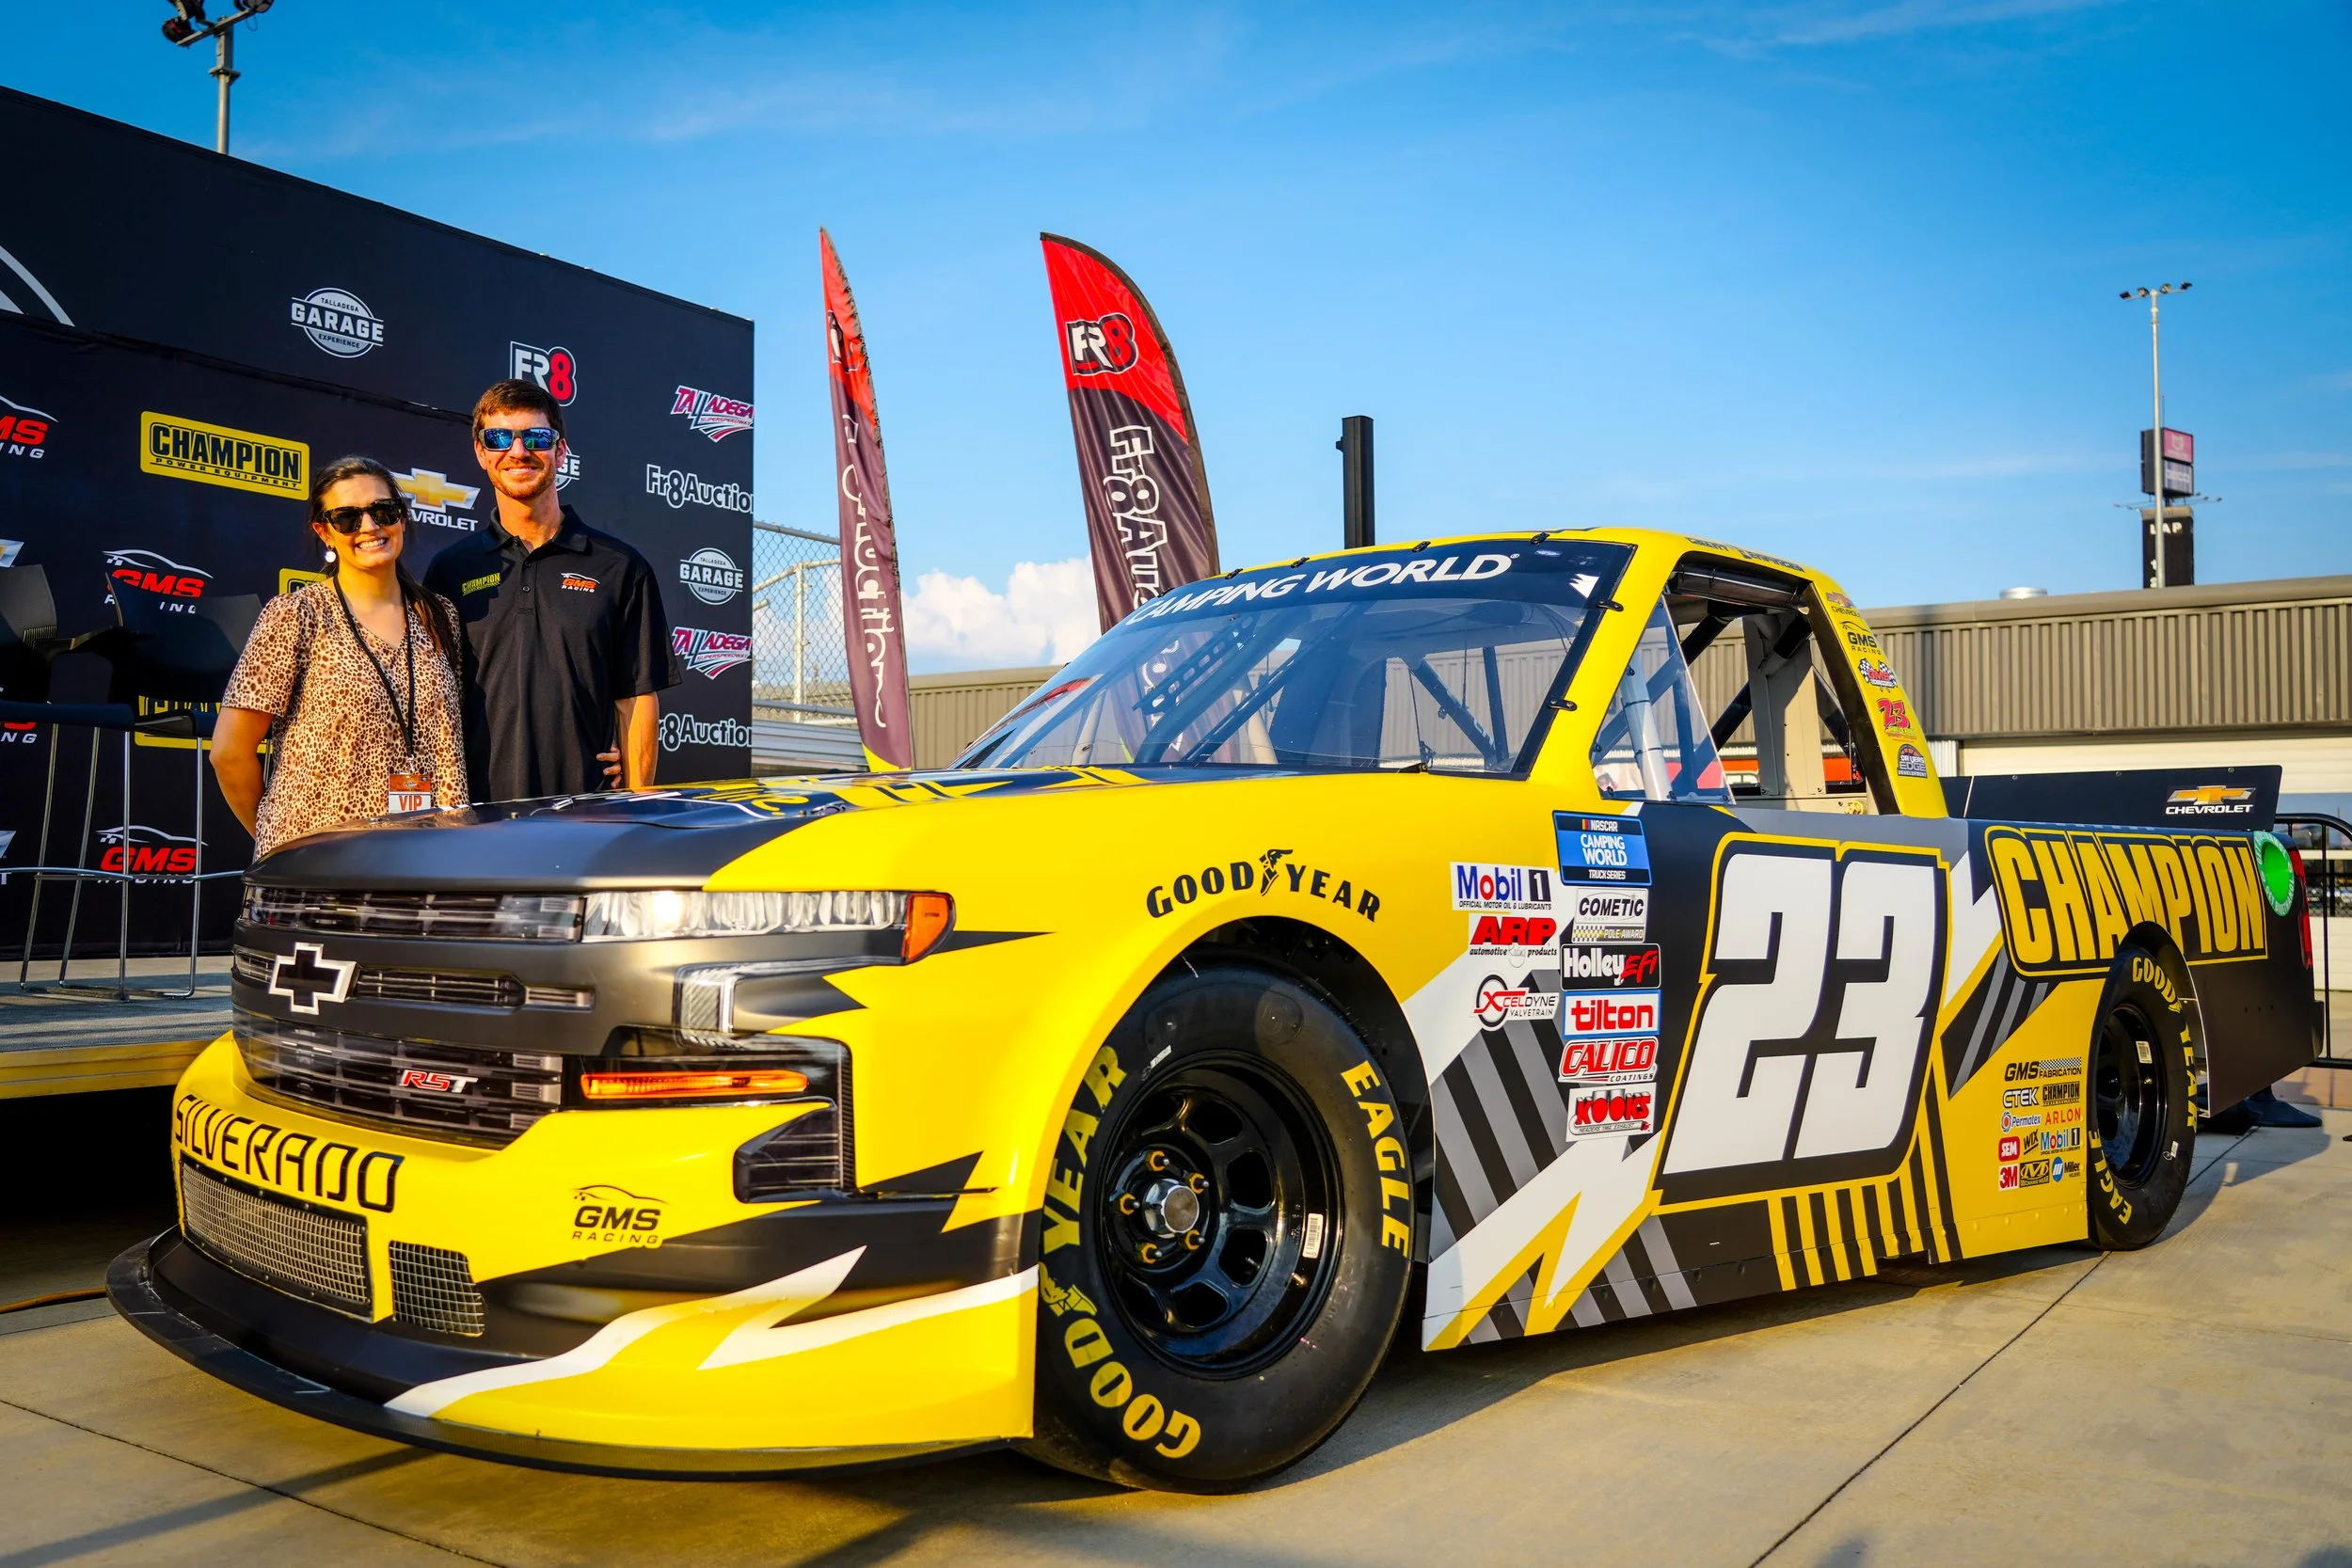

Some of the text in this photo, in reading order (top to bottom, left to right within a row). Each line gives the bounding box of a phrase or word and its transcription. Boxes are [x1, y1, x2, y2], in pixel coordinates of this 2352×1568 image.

[321, 297, 359, 313] TALLADEGA
[291, 302, 384, 342] GARAGE
[318, 333, 360, 349] EXPERIENCE
[1071, 319, 1132, 368] FR8
[515, 348, 572, 401] FR8
[670, 386, 754, 429] TALLADEGA
[699, 416, 752, 427] SUPERSPEEDWAY
[151, 422, 300, 482] CHAMPION
[155, 457, 298, 488] POWER EQUIPMENT
[408, 508, 479, 532] VROLET
[461, 572, 501, 593] CHAMPION
[562, 578, 597, 590] GMS
[679, 563, 744, 589] GARAGE
[561, 584, 596, 594] RACING
[698, 587, 727, 596] EXPERIENCE
[1125, 553, 1512, 626] CAMPING WORLD
[1831, 605, 1861, 618] CHEVROL
[672, 626, 753, 670] TALLADEGA
[1847, 631, 1878, 648] GMS
[1851, 644, 1882, 656] RACING
[1876, 697, 1911, 729] 23
[658, 712, 753, 752] r8Auctio
[1899, 762, 1927, 772] EDGE
[398, 795, 422, 812] VIP
[2165, 803, 2254, 816] CHEVROLET
[1590, 819, 1618, 832] NASCAR
[1581, 833, 1626, 850] CAMPING
[100, 847, 197, 872] GMS
[1581, 847, 1628, 866] WORLD
[1456, 864, 1548, 903] Mobil 1
[1588, 869, 1626, 880] TRUCK SERIES
[1459, 900, 1482, 909] OFFICIAL
[1484, 901, 1502, 910] MOTOR
[1518, 902, 1552, 911] LUBRICANTS
[1579, 897, 1645, 917] COMETIC
[1991, 837, 2265, 965] CHAMPION
[1470, 915, 1557, 946] ARP
[1604, 928, 1644, 939] POLE AWARD
[1470, 945, 1507, 957] automotive
[1527, 946, 1558, 958] products
[1563, 947, 1659, 986] Holley EFI
[1473, 990, 1557, 1014] XCELDYNE
[1509, 1008, 1554, 1018] VALVETRAIN
[1571, 999, 1654, 1032] tilton
[1661, 853, 1936, 1176] 23
[1561, 1039, 1657, 1077] CALICO
[399, 1069, 479, 1094] RST
[1610, 1073, 1654, 1083] COATINGS
[2004, 1061, 2082, 1082] GMS FABRICATION
[2002, 1086, 2040, 1108] CTEK
[2042, 1082, 2080, 1102] CHAMPION
[1574, 1093, 1652, 1126] KOOKS
[2044, 1106, 2082, 1126] ARLON
[2011, 1116, 2042, 1128] Permatex
[2000, 1140, 2018, 1158] SEM
[2023, 1128, 2039, 1150] WIX
[2041, 1128, 2069, 1151] Mobil
[2072, 1128, 2080, 1146] 1
[175, 1094, 405, 1213] SILVERADO
[1340, 1059, 1412, 1259] EAGLE
[1999, 1165, 2018, 1189] 3M
[2087, 1129, 2134, 1226] EAGLE
[574, 1205, 660, 1231] GMS
[571, 1230, 660, 1244] RACING
